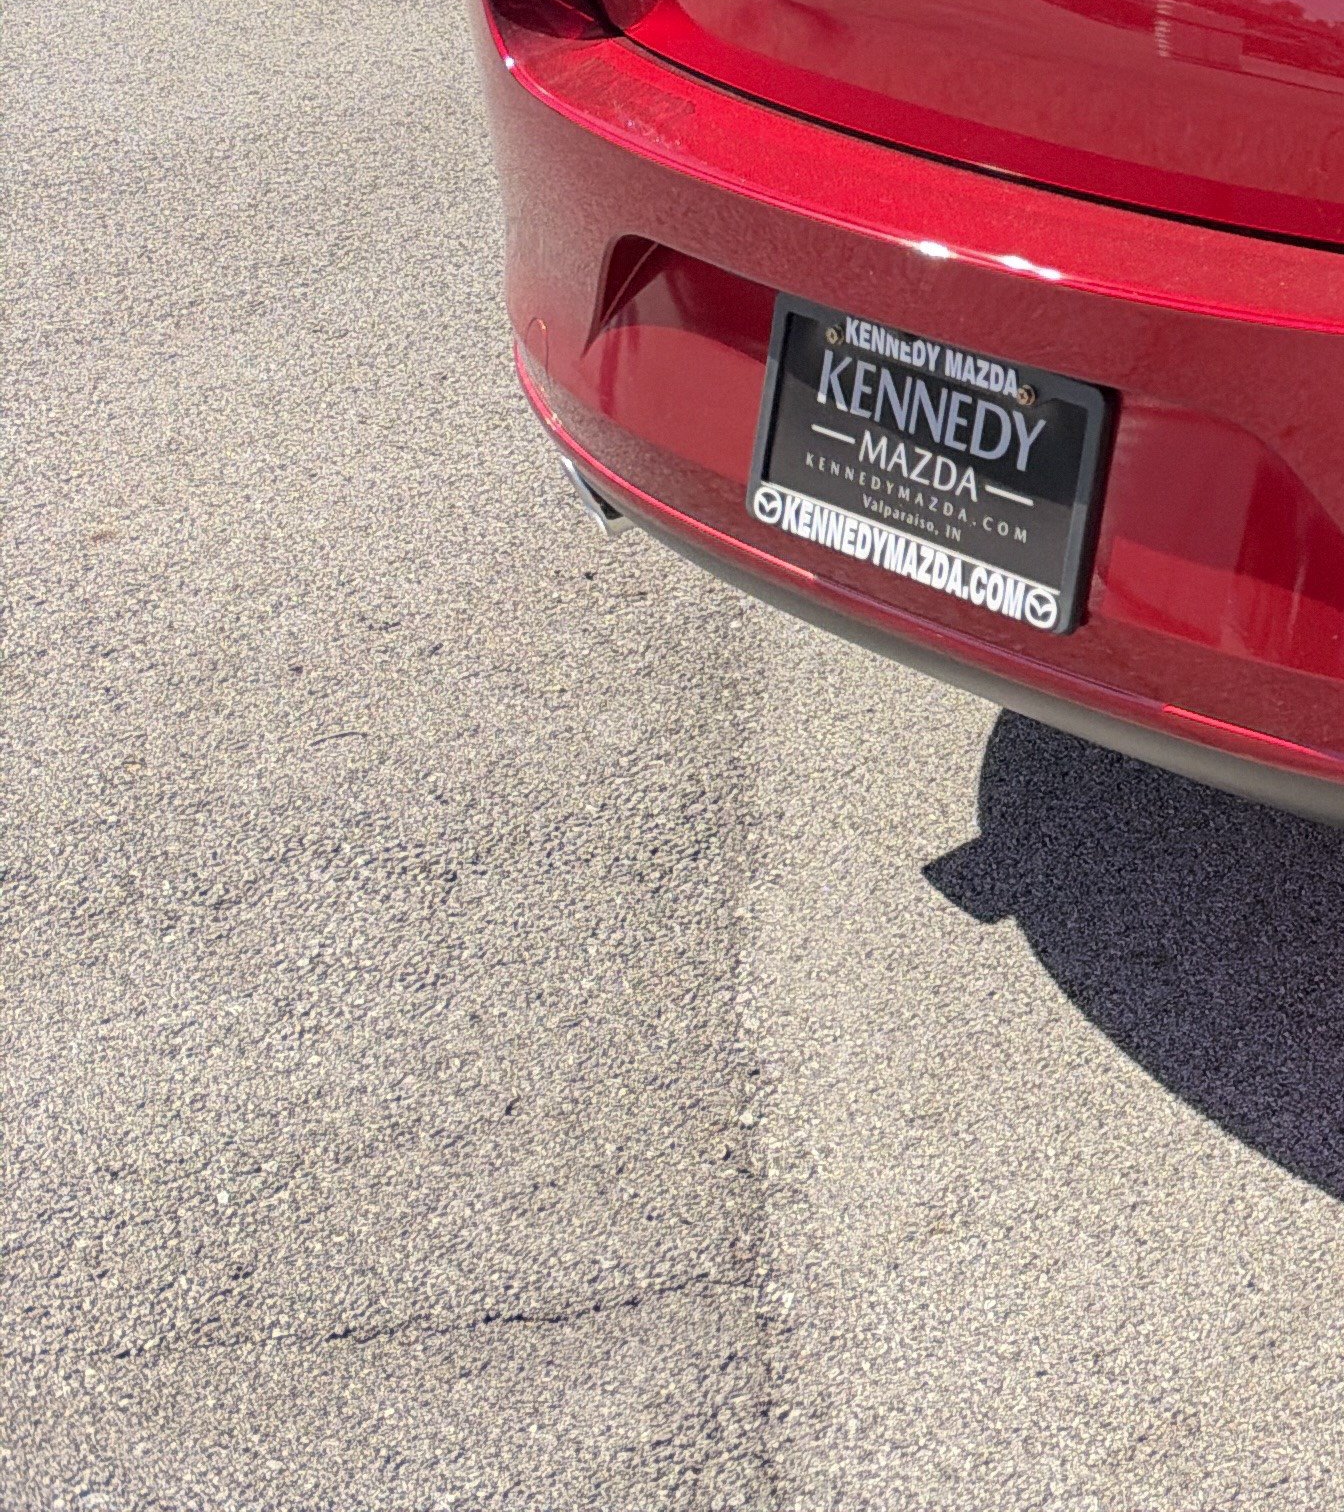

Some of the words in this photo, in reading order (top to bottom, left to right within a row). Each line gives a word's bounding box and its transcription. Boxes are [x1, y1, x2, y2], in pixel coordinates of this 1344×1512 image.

[844, 315, 940, 373] KENNEDY
[944, 348, 1020, 399] MAZDA
[815, 349, 1047, 473] KENNEDY
[804, 451, 1028, 544] KENNEDYMAZDA.COM
[857, 429, 979, 503] MAZDA
[780, 495, 1027, 622] KENNEDYMAZDA.COM
[862, 492, 940, 536] Valparaiso,
[944, 524, 962, 543] IN
